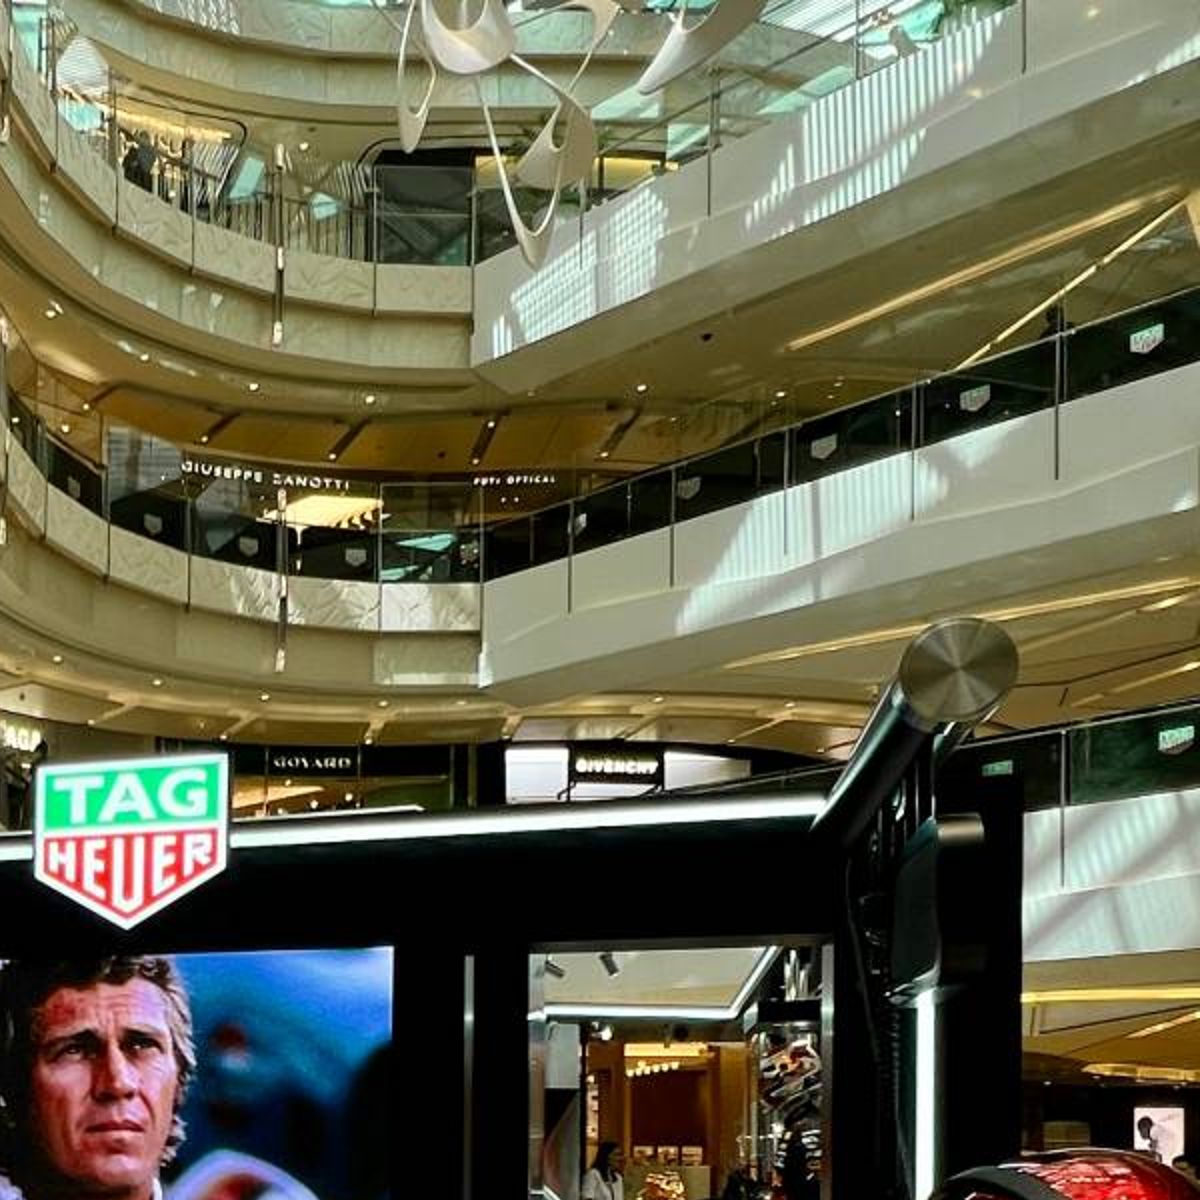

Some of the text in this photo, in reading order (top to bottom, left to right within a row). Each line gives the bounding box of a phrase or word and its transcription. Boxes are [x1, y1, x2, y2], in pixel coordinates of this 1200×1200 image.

[181, 461, 350, 490] GIUSEPPE ZANOTTI
[506, 475, 556, 485] OPTICAL
[576, 758, 659, 775] GIVENCHY
[53, 768, 209, 825] TAG
[48, 832, 213, 914] HEUER
